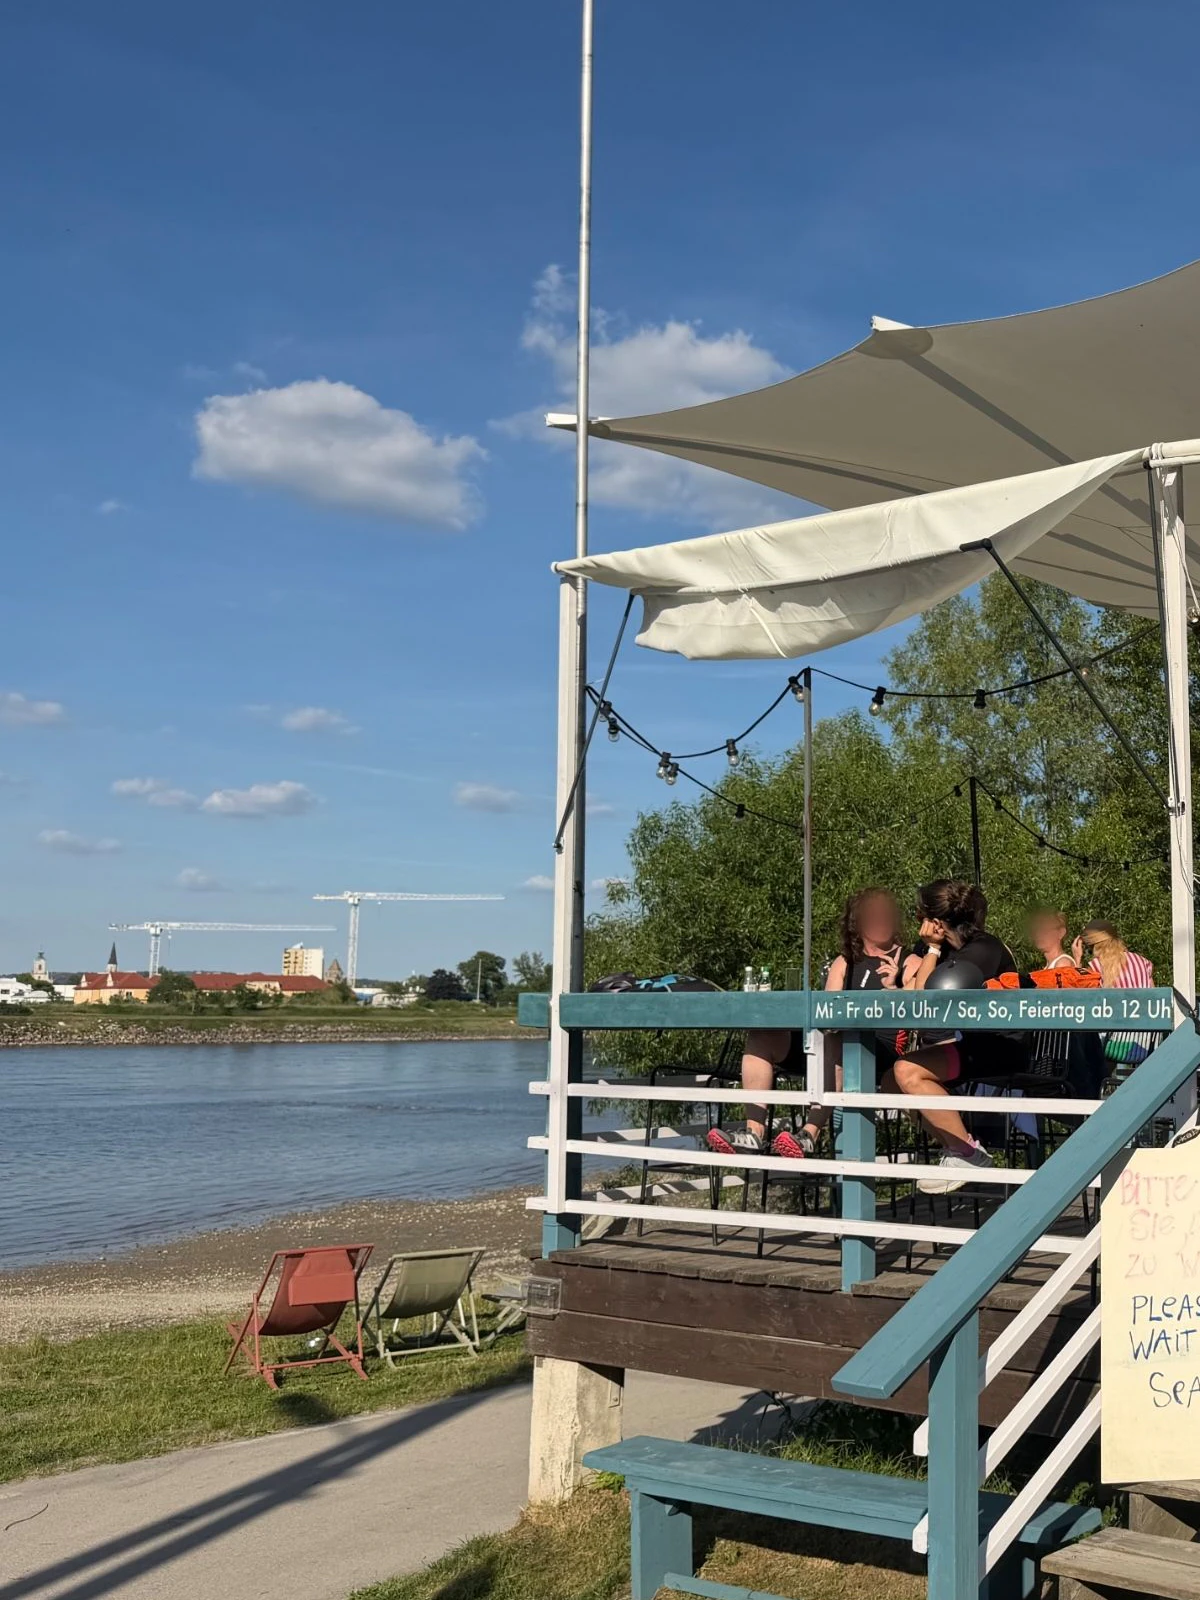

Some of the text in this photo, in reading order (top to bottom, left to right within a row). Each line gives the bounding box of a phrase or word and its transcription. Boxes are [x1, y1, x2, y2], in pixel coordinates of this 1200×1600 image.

[815, 1003, 833, 1020] Mi
[846, 1003, 860, 1019] Fr
[864, 1001, 883, 1019] ab
[890, 1002, 906, 1019] 16
[912, 1000, 939, 1019] Uhr
[957, 1002, 981, 1022] Sa,
[988, 1001, 1013, 1022] So,
[1019, 1000, 1085, 1023] Feiertag
[1091, 999, 1113, 1019] ab
[1121, 999, 1140, 1019] 12
[1147, 998, 1173, 1019] Uh
